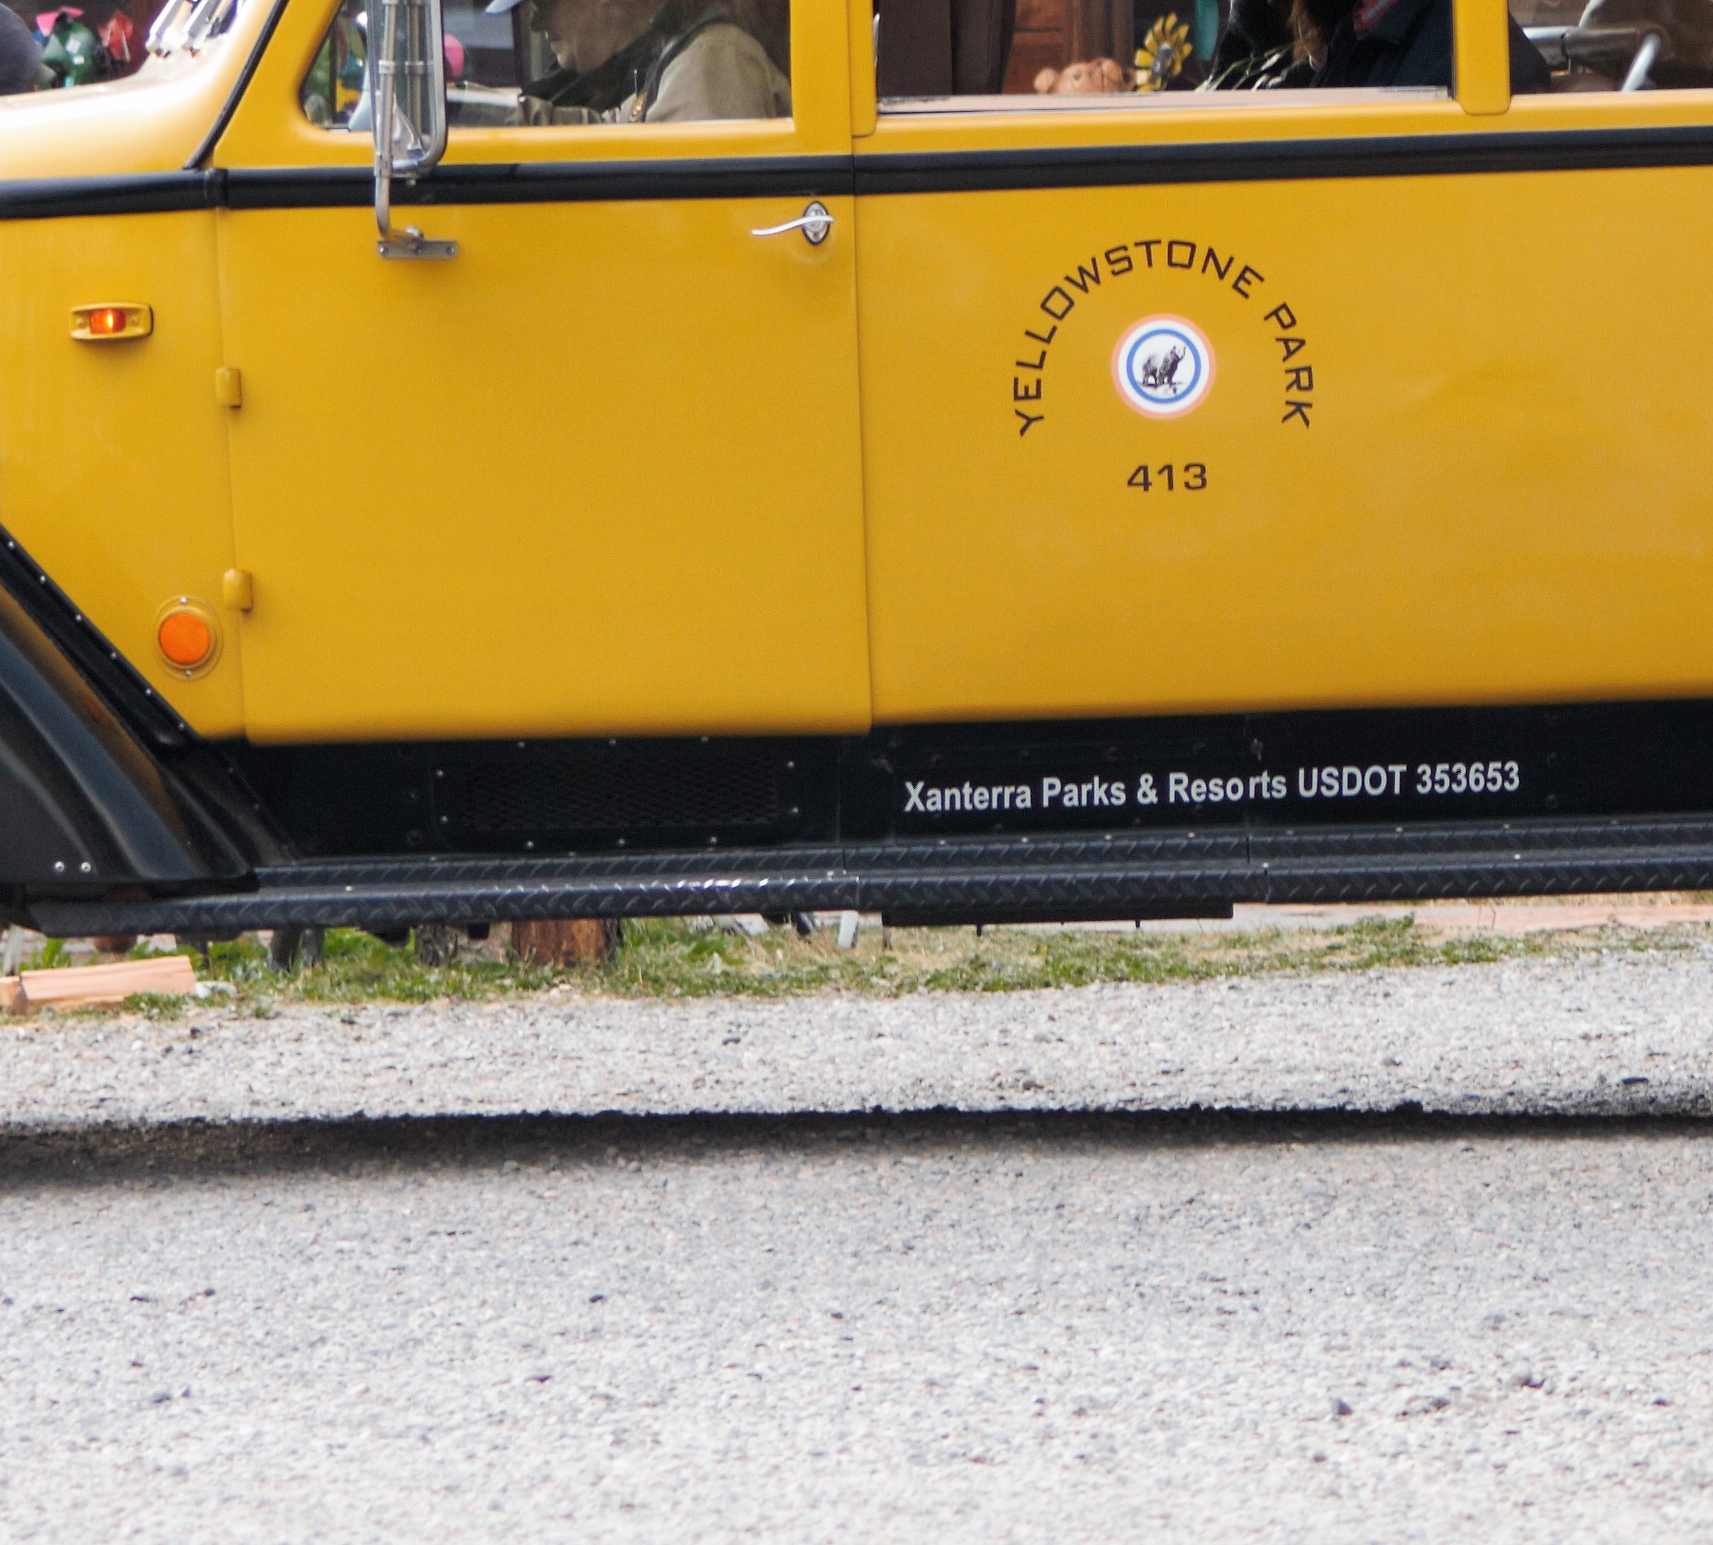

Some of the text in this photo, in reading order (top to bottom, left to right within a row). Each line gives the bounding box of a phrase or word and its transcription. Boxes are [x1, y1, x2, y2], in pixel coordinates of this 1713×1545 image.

[1013, 240, 1314, 437] YELLOWSTONE PARK
[1127, 462, 1208, 492] 413
[904, 760, 1520, 813] Xanterra Parks & Resorts USDOT 353653
